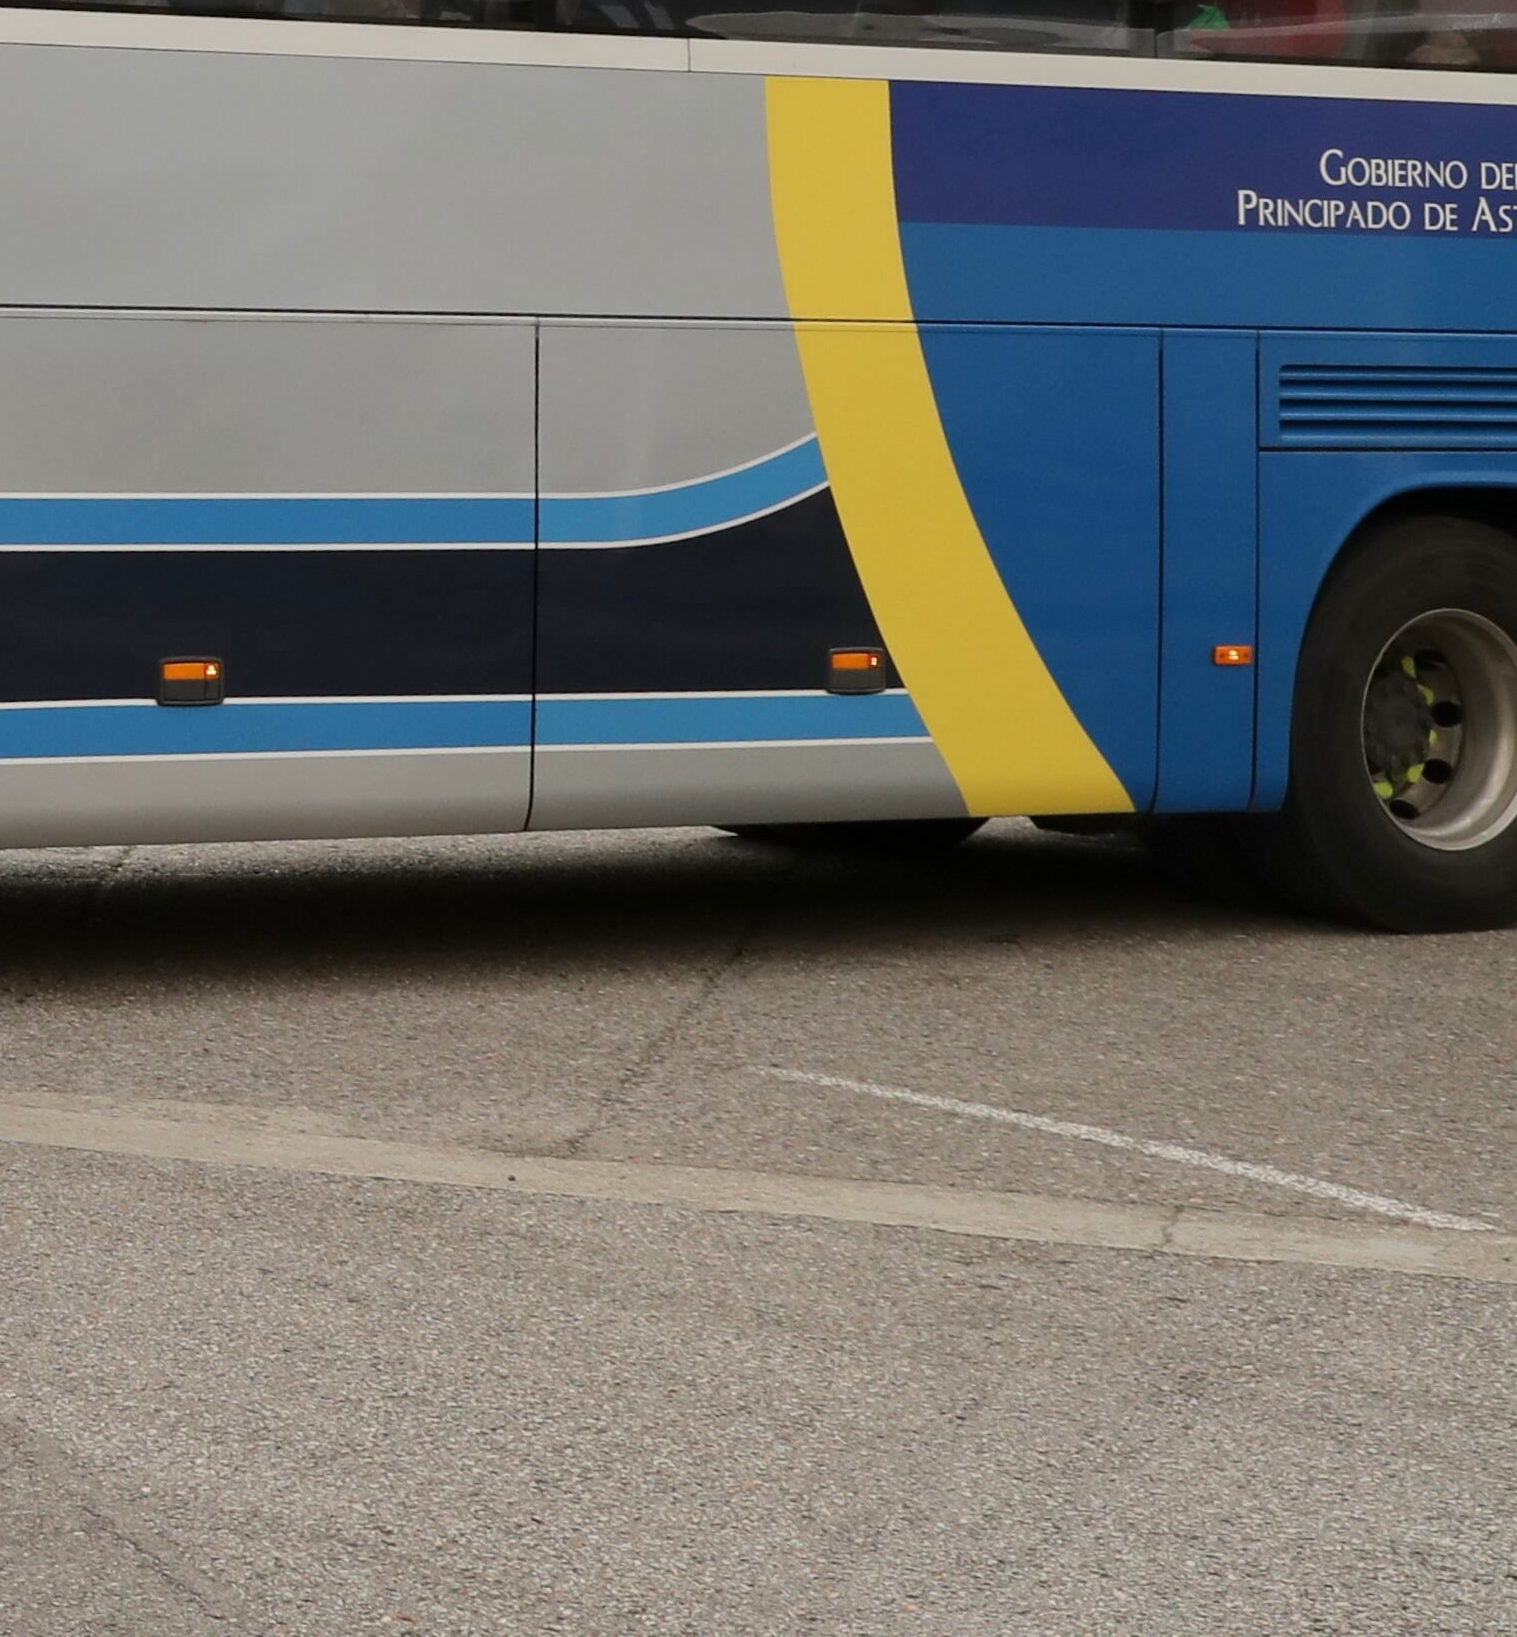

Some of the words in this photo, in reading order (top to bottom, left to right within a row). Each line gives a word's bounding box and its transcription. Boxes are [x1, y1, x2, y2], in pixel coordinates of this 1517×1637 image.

[1319, 148, 1468, 190] GOBIERNO
[1480, 162, 1517, 190] DE
[1237, 189, 1412, 231] PRINCIPADO
[1424, 203, 1459, 232] DE
[1471, 197, 1517, 232] AS
